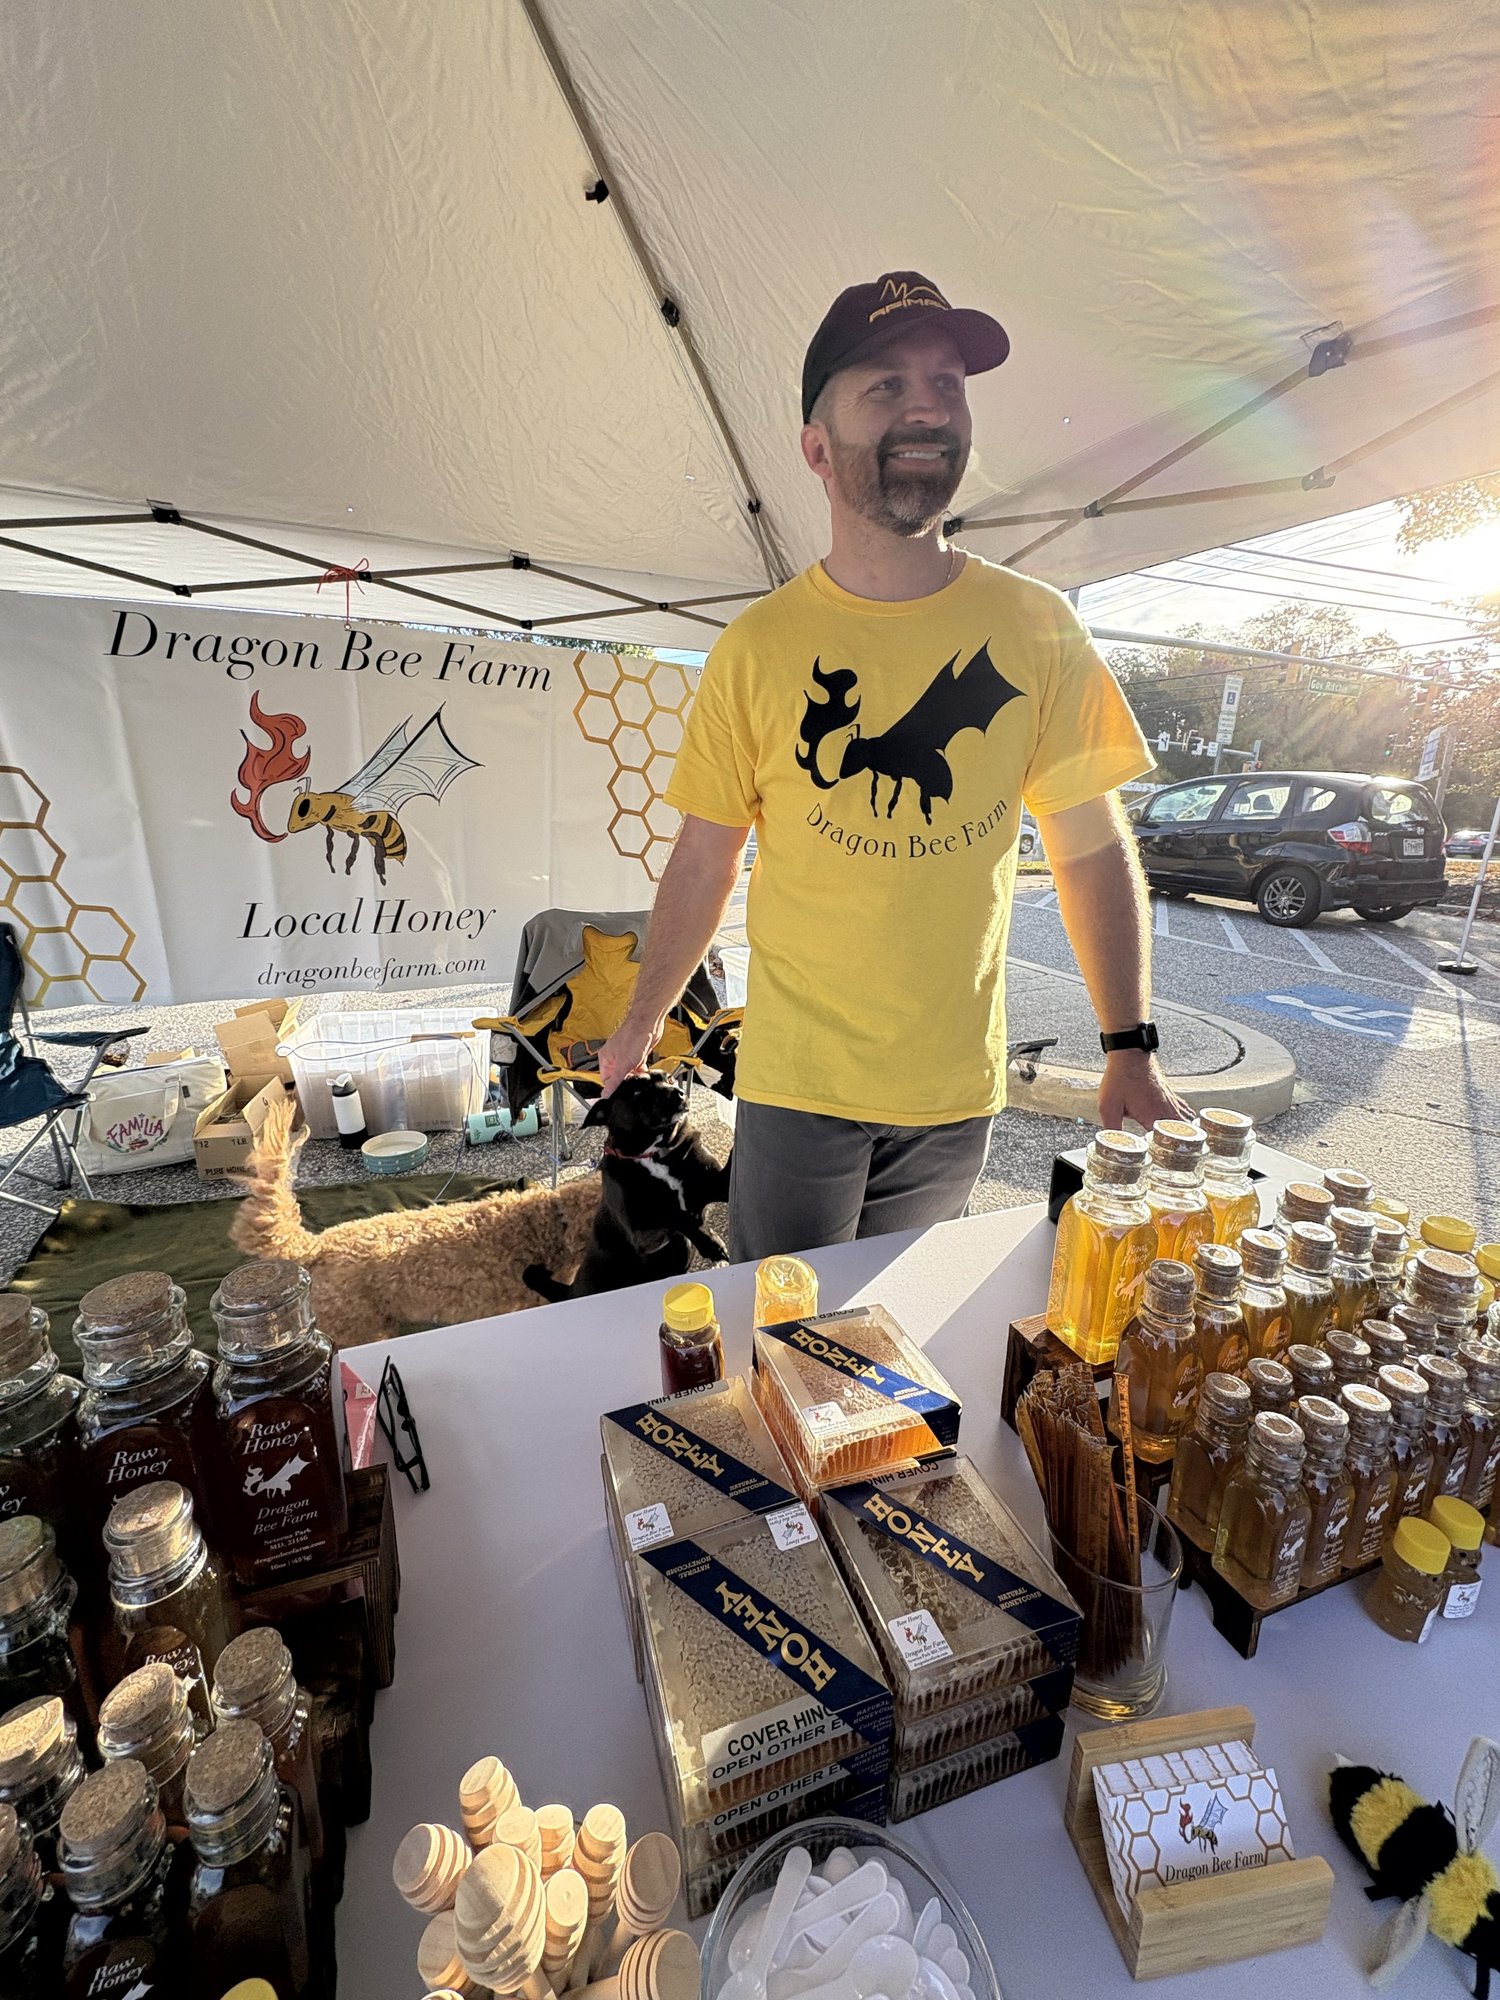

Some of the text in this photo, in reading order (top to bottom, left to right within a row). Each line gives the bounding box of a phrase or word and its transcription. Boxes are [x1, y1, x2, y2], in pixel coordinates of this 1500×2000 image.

[103, 610, 553, 692] Dragon Bee Farm
[806, 800, 1008, 858] Dragon Bee Farm
[237, 898, 497, 940] Local Honey
[257, 955, 487, 990] dragonbeefarm.com
[205, 1165, 251, 1176] PURE HONE
[789, 1328, 886, 1385] HONEY
[674, 1382, 714, 1399] COVER
[250, 1420, 291, 1439] Raw
[241, 1431, 303, 1456] Honey
[635, 1411, 725, 1478] HONEY
[112, 1447, 158, 1468] Raw
[105, 1458, 172, 1485] Honey
[898, 1462, 939, 1479] COVER
[729, 1477, 758, 1491] NATURAL
[729, 1480, 769, 1497] HONEYCOMB
[257, 1499, 310, 1520] Dragon
[253, 1509, 318, 1536] Bee Farm
[863, 1493, 985, 1583] HONEY
[665, 1555, 712, 1577] HONEYCOMB
[678, 1563, 710, 1579] NATURAL
[997, 1586, 1028, 1601] NATURAL
[999, 1591, 1043, 1611] HONEYCOMB
[896, 1614, 923, 1627] Raw Honey
[714, 1580, 837, 1692] HONEY
[145, 1648, 182, 1666] Raw
[904, 1648, 923, 1659] Dragon
[932, 1639, 946, 1648] Farm
[727, 1718, 791, 1757] COVER
[712, 1750, 762, 1779] OPEN
[767, 1725, 826, 1756] OTHER
[713, 1798, 761, 1826] OPEN
[767, 1770, 824, 1802] OTHER
[1165, 1850, 1264, 1882] Dragon Bee Farm
[86, 1963, 147, 1997] Honey
[93, 1957, 135, 1981] Raw
